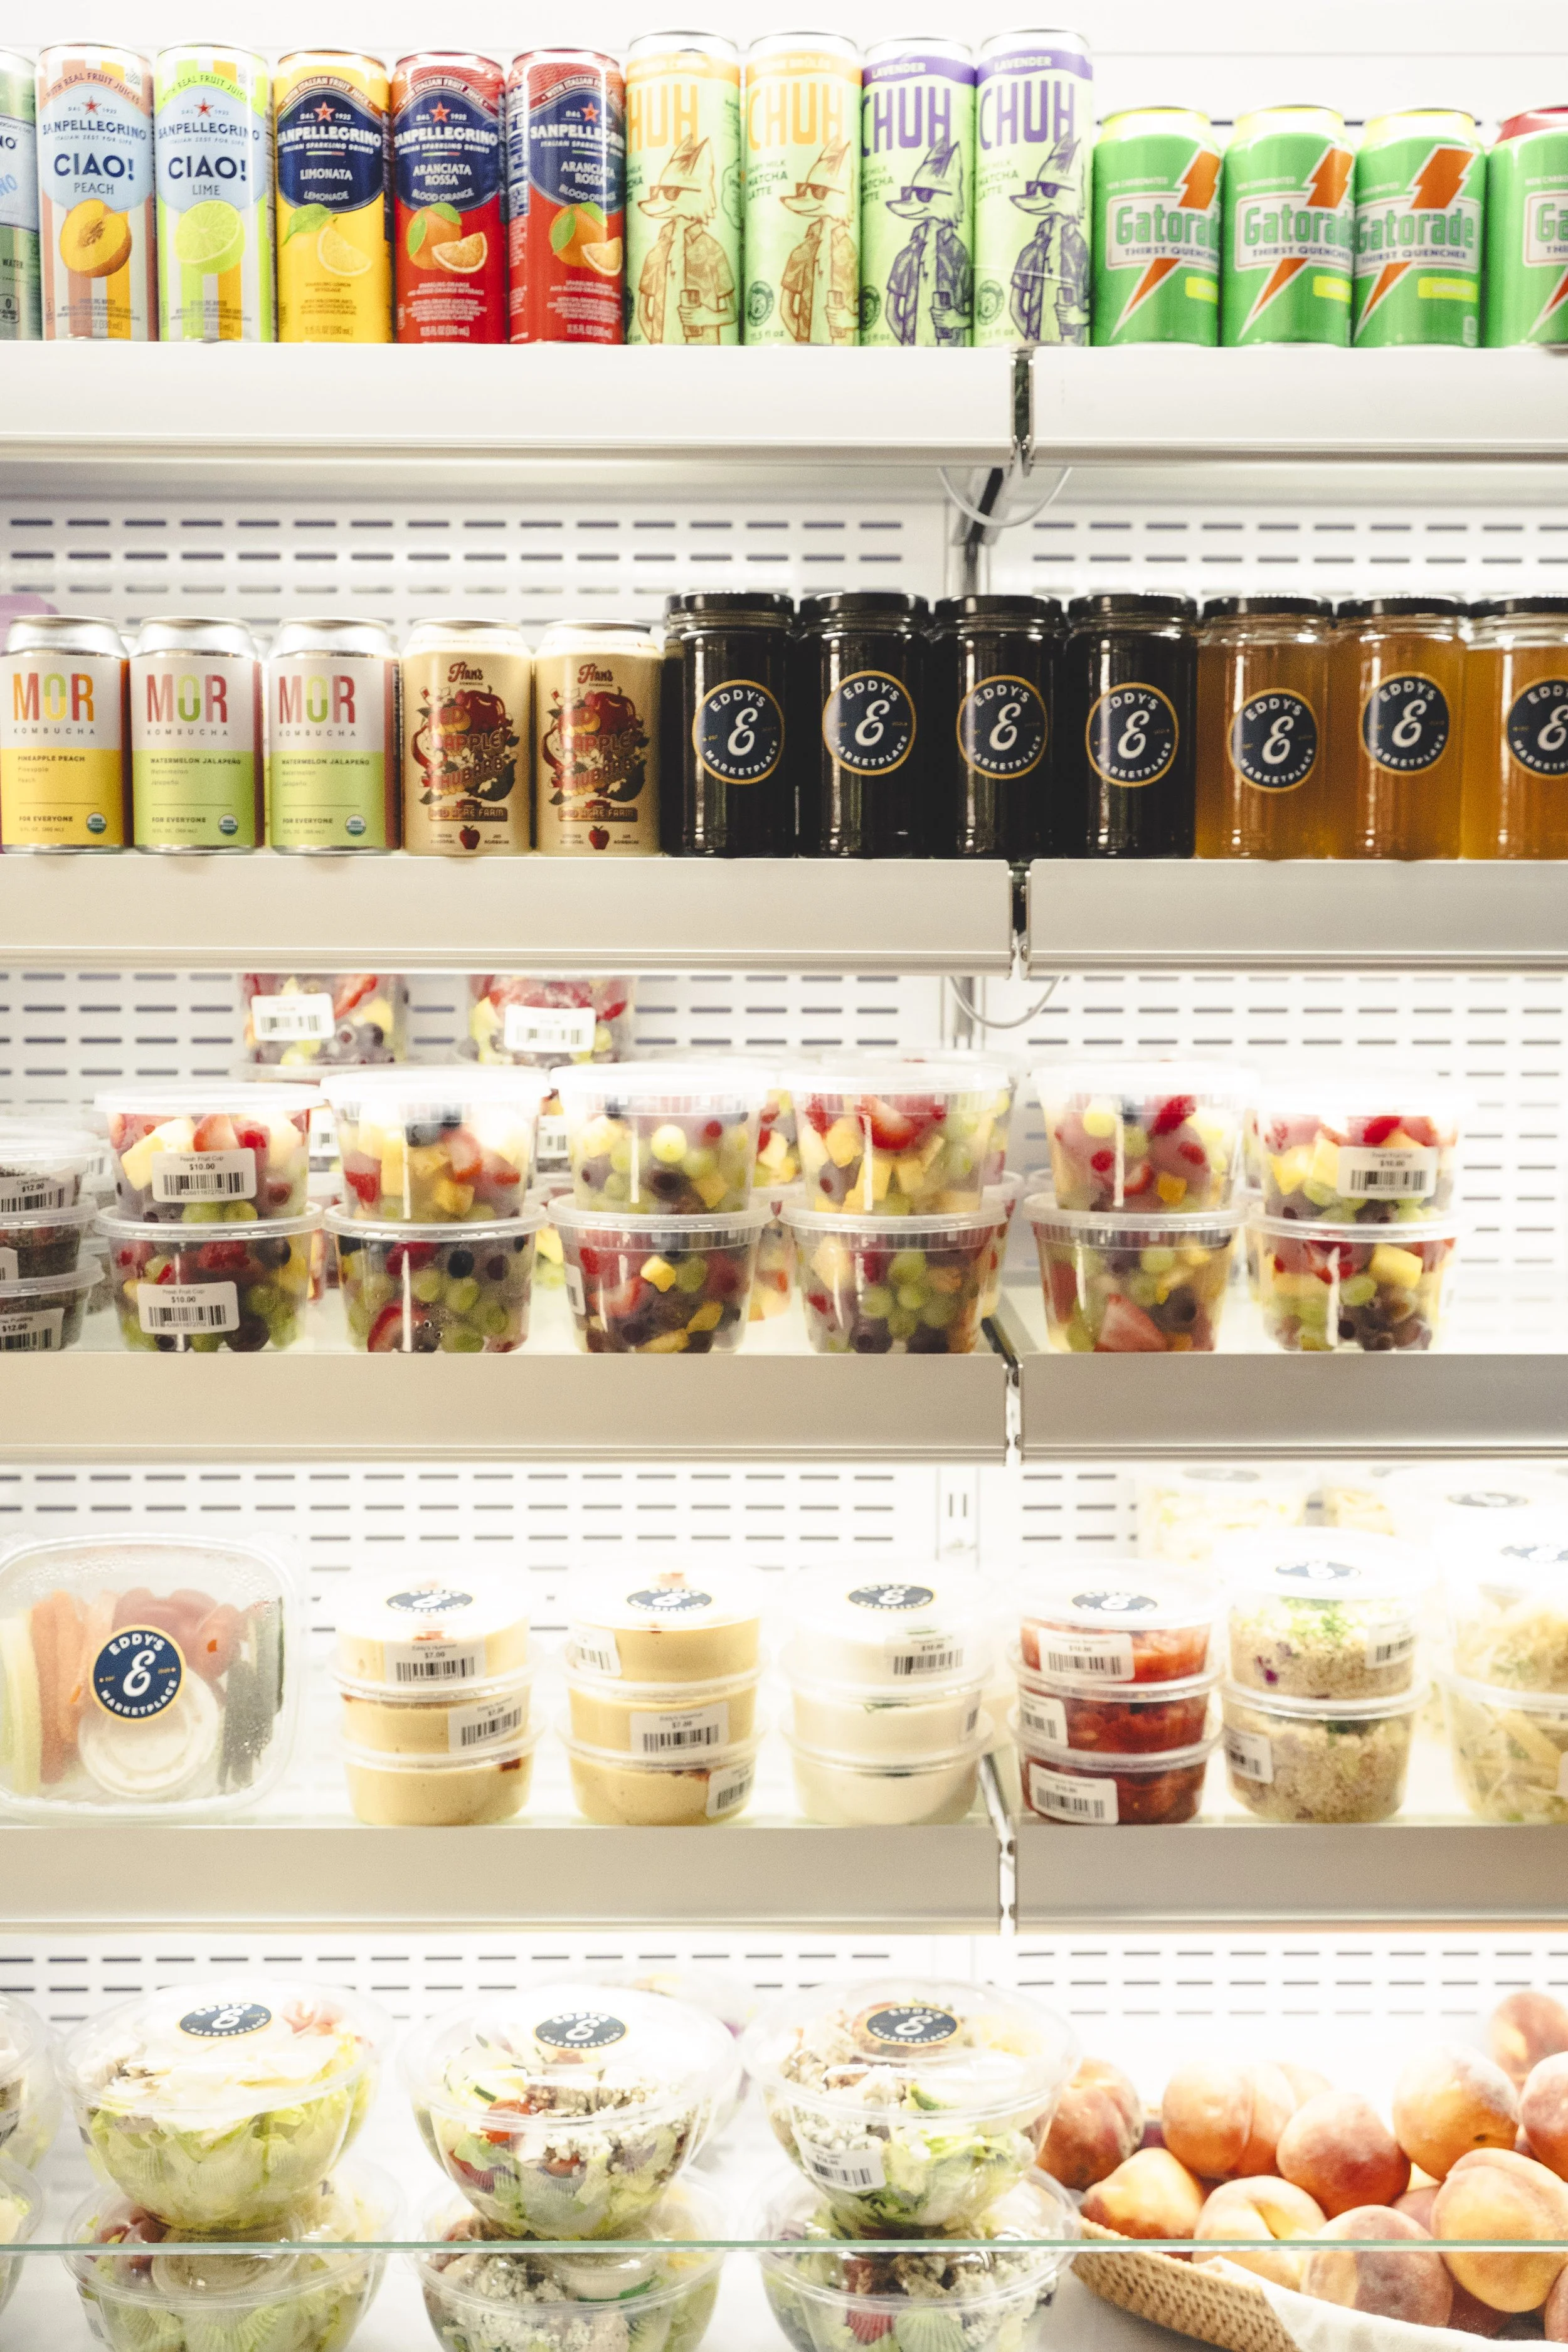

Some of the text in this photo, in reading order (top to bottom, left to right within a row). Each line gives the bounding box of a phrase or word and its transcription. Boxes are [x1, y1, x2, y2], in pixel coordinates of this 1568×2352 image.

[64, 73, 85, 84] REAL
[87, 72, 113, 85] FRUIT
[114, 83, 140, 105] JUICES
[200, 75, 225, 87] FRUIT
[227, 84, 248, 101] JUIC
[43, 119, 147, 140] SANPELLEGRINO
[394, 126, 498, 148] SANPELLEGRINO
[54, 153, 134, 181] CIAO!
[169, 155, 247, 182] CIAO!
[300, 167, 353, 181] LIMONATA
[413, 163, 472, 176] ARANCIATA
[74, 182, 115, 194] PEACH
[192, 184, 221, 196] LIME
[425, 174, 458, 186] ROSSA
[304, 190, 350, 201] LEMONADE
[411, 188, 474, 202] BLOOD ORANGE
[1244, 203, 1354, 248] Gatorad
[1354, 208, 1474, 255] Gatorade
[13, 672, 95, 722] MOR
[147, 674, 228, 724] MOR
[278, 674, 356, 724] MOR
[709, 689, 766, 712] EDDY'S
[842, 680, 900, 701] EDDY'S
[973, 684, 1030, 707] EDDY'S
[1527, 684, 1568, 704] EDD
[1102, 692, 1159, 715] DDY'S
[1245, 697, 1303, 721] EDDY'S
[147, 728, 228, 736] KOMBUCHA
[278, 729, 356, 737] KOMBUCHA
[443, 728, 503, 752] APPLE
[573, 729, 632, 752] APPLE
[705, 739, 778, 776] MARKETPLACE
[1370, 734, 1445, 768] ARKETPLACE
[479, 808, 504, 817] FARM
[189, 1163, 215, 1171] $10.00
[171, 1295, 196, 1303] $10.00
[109, 1633, 165, 1656] EDDY'S
[101, 1680, 178, 1716] MARKETPLACE
